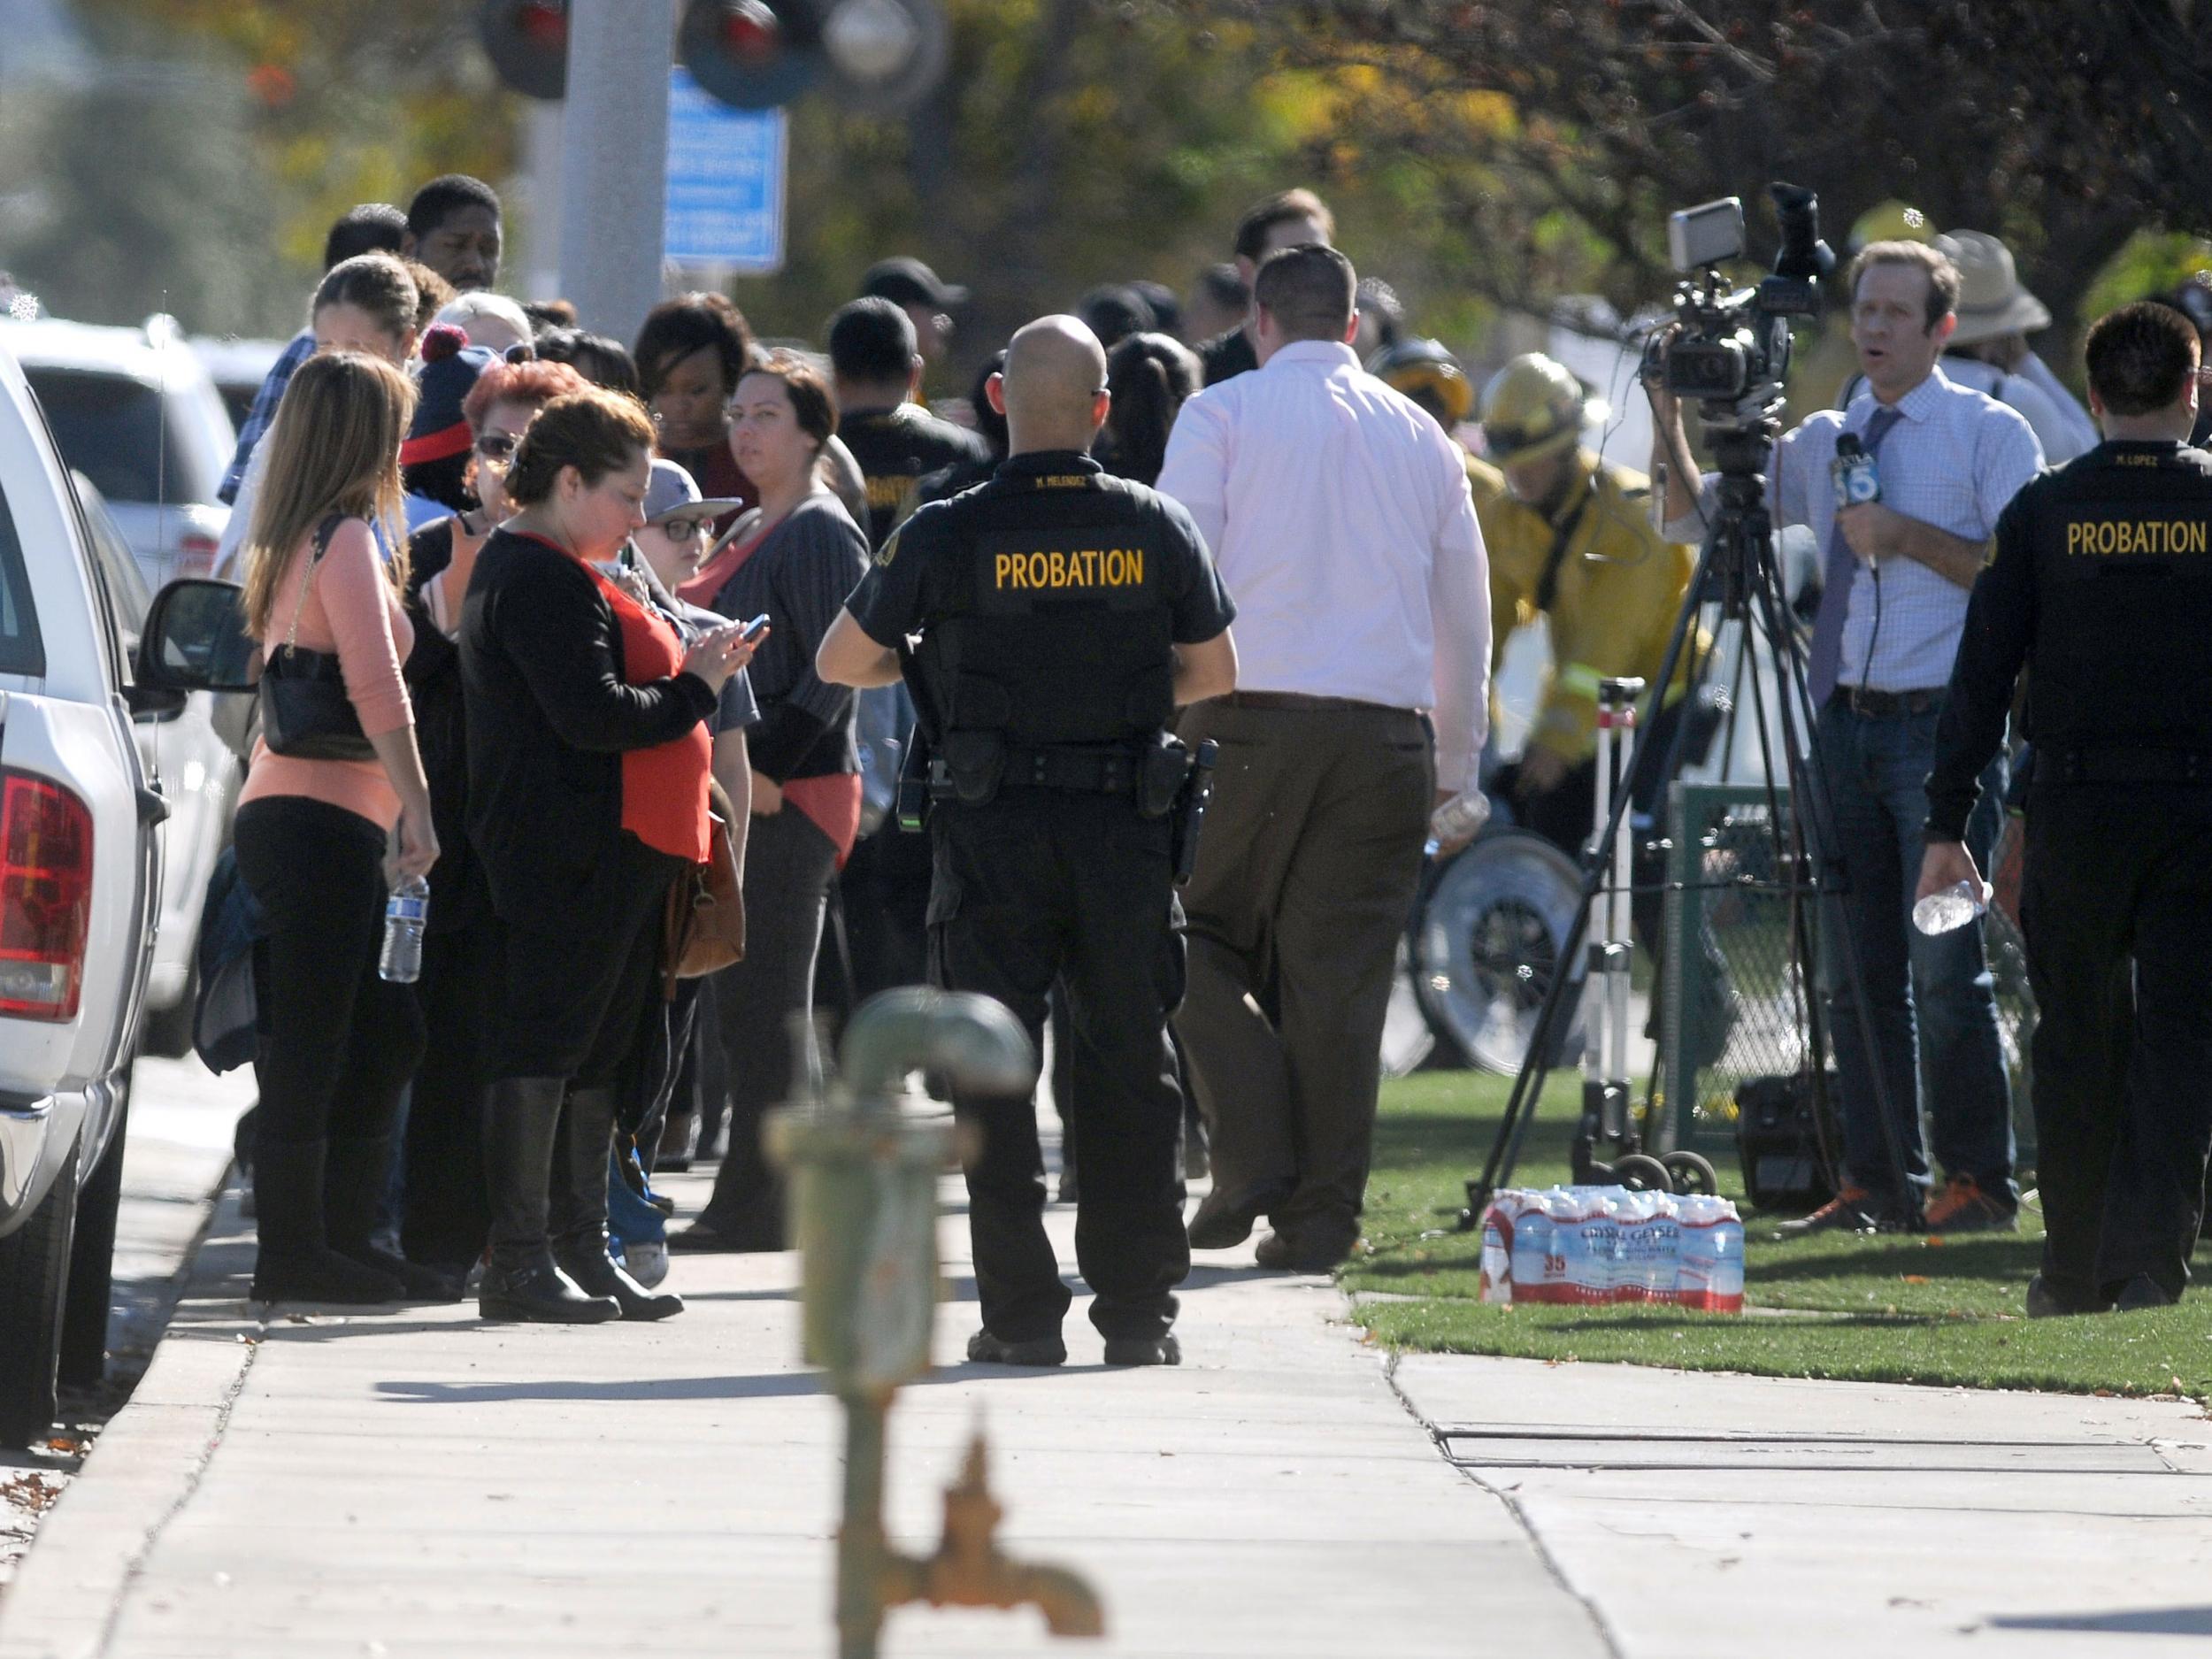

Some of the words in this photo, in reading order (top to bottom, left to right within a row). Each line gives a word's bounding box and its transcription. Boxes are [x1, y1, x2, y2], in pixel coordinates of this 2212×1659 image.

[2127, 453, 2158, 467] LOPEZ
[1047, 474, 1087, 488] MELENDEZ
[1849, 465, 1878, 501] 5
[2067, 520, 2207, 555] PROBATION
[995, 549, 1143, 589] PROBATION
[1544, 1254, 1565, 1271] 35
